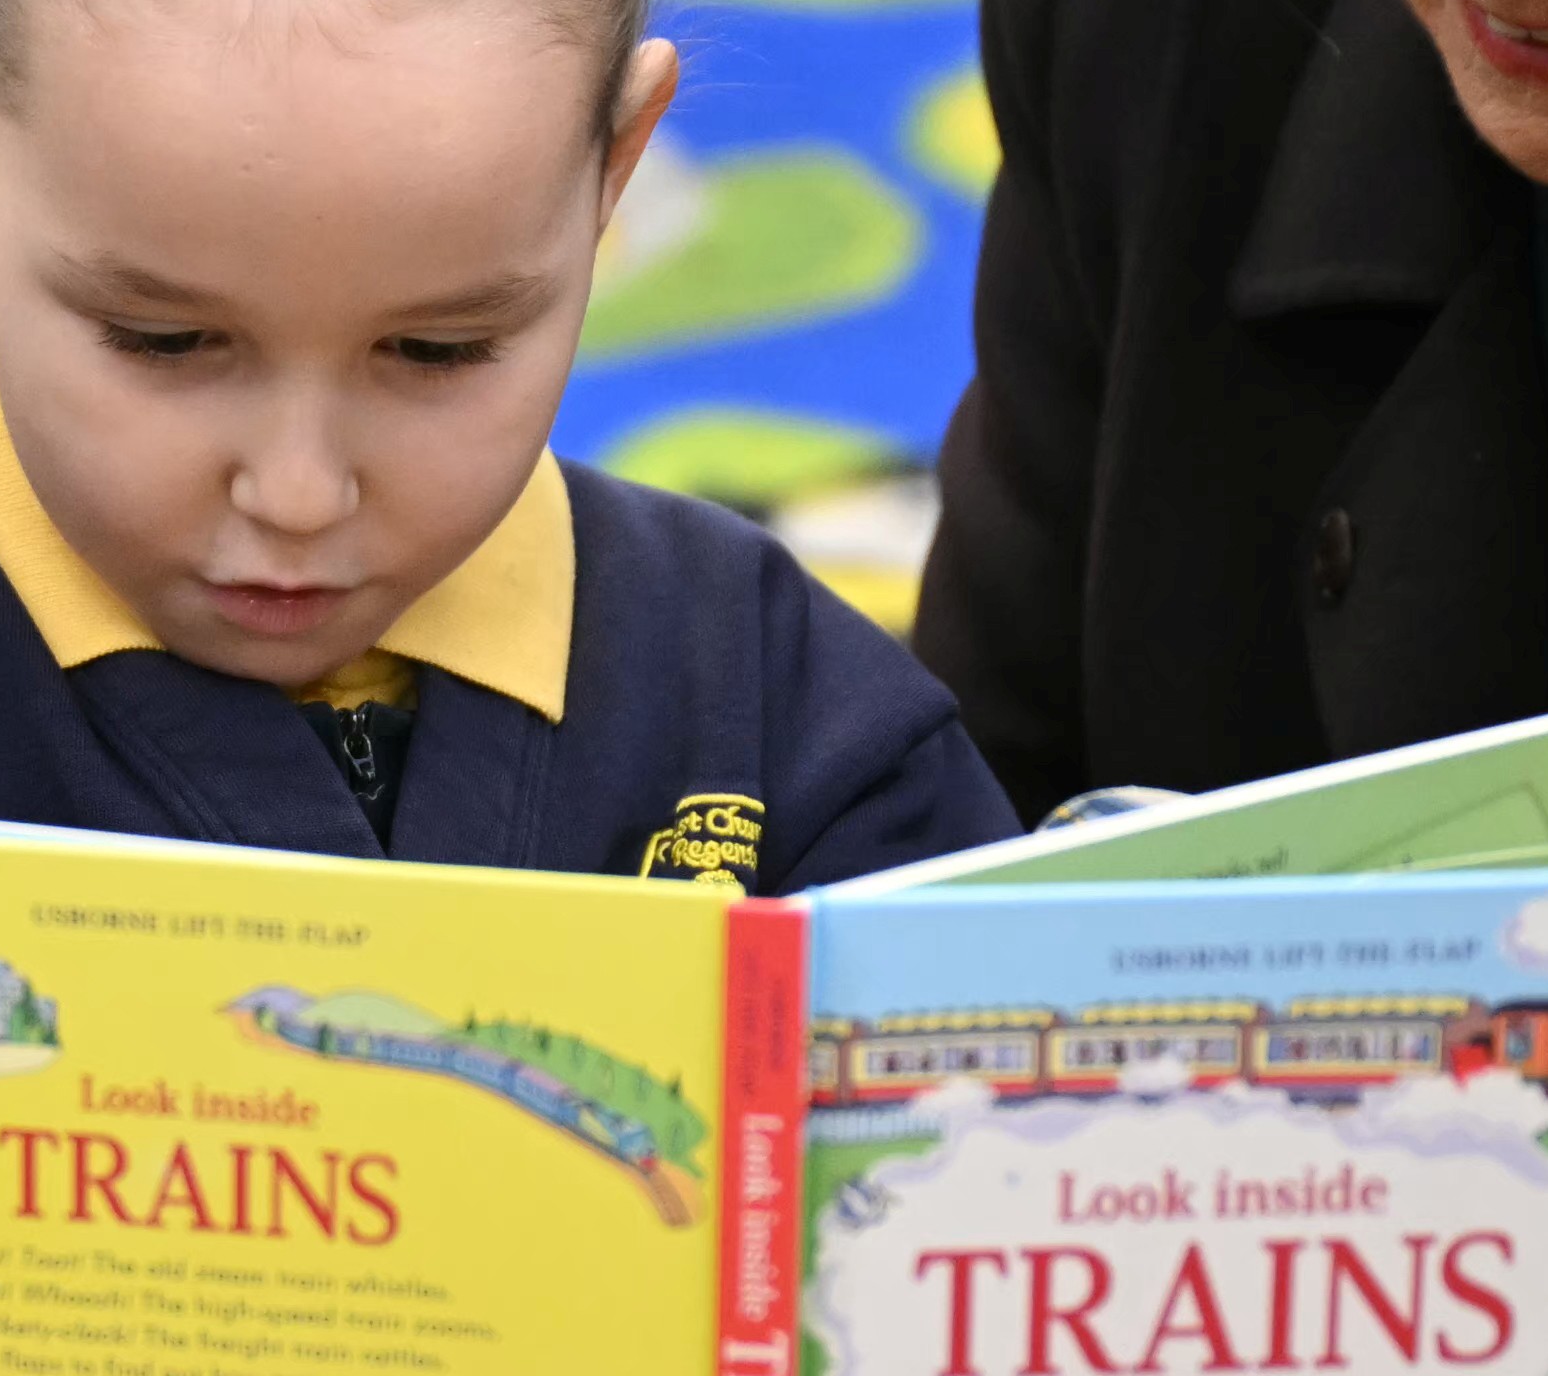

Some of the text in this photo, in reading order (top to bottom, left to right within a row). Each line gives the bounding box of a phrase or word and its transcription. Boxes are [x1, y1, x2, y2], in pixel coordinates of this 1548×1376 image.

[1257, 941, 1323, 967] LIFT
[1332, 938, 1386, 965] THE
[1396, 935, 1483, 963] FLAP
[78, 1071, 322, 1131] Look inside
[741, 1112, 786, 1209] Look
[1056, 1161, 1389, 1225] Look inside
[735, 1210, 784, 1321] inside
